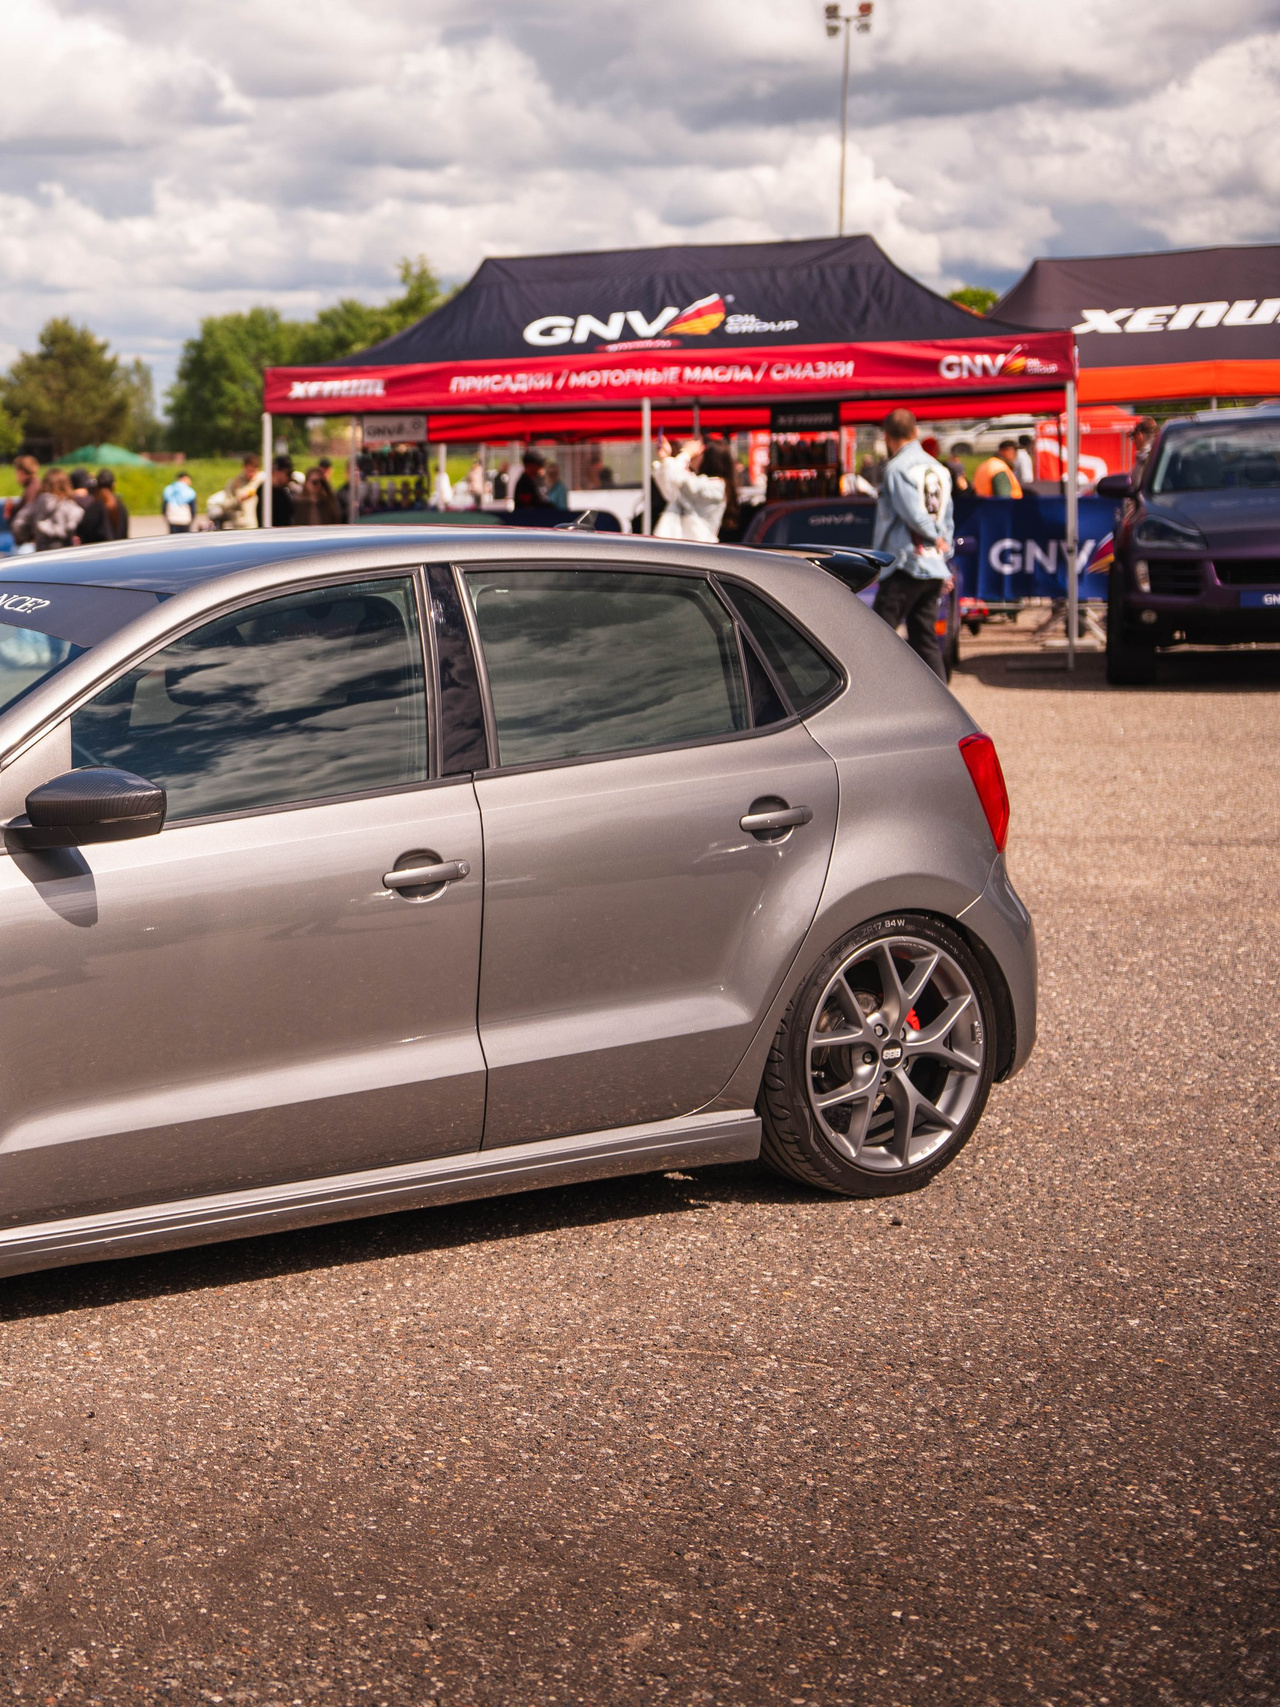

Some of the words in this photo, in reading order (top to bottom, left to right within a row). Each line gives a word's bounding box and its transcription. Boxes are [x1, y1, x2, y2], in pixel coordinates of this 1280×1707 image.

[523, 306, 679, 346] GNV
[1071, 298, 1280, 334] XENU
[449, 372, 554, 394] ПРИСАДКИ
[569, 366, 680, 388] МОТОРНЫЕ
[681, 365, 753, 383] МАСЛА
[770, 360, 855, 381] СМАЗКИ
[939, 353, 1006, 379] GNV
[989, 538, 1096, 575] GNV
